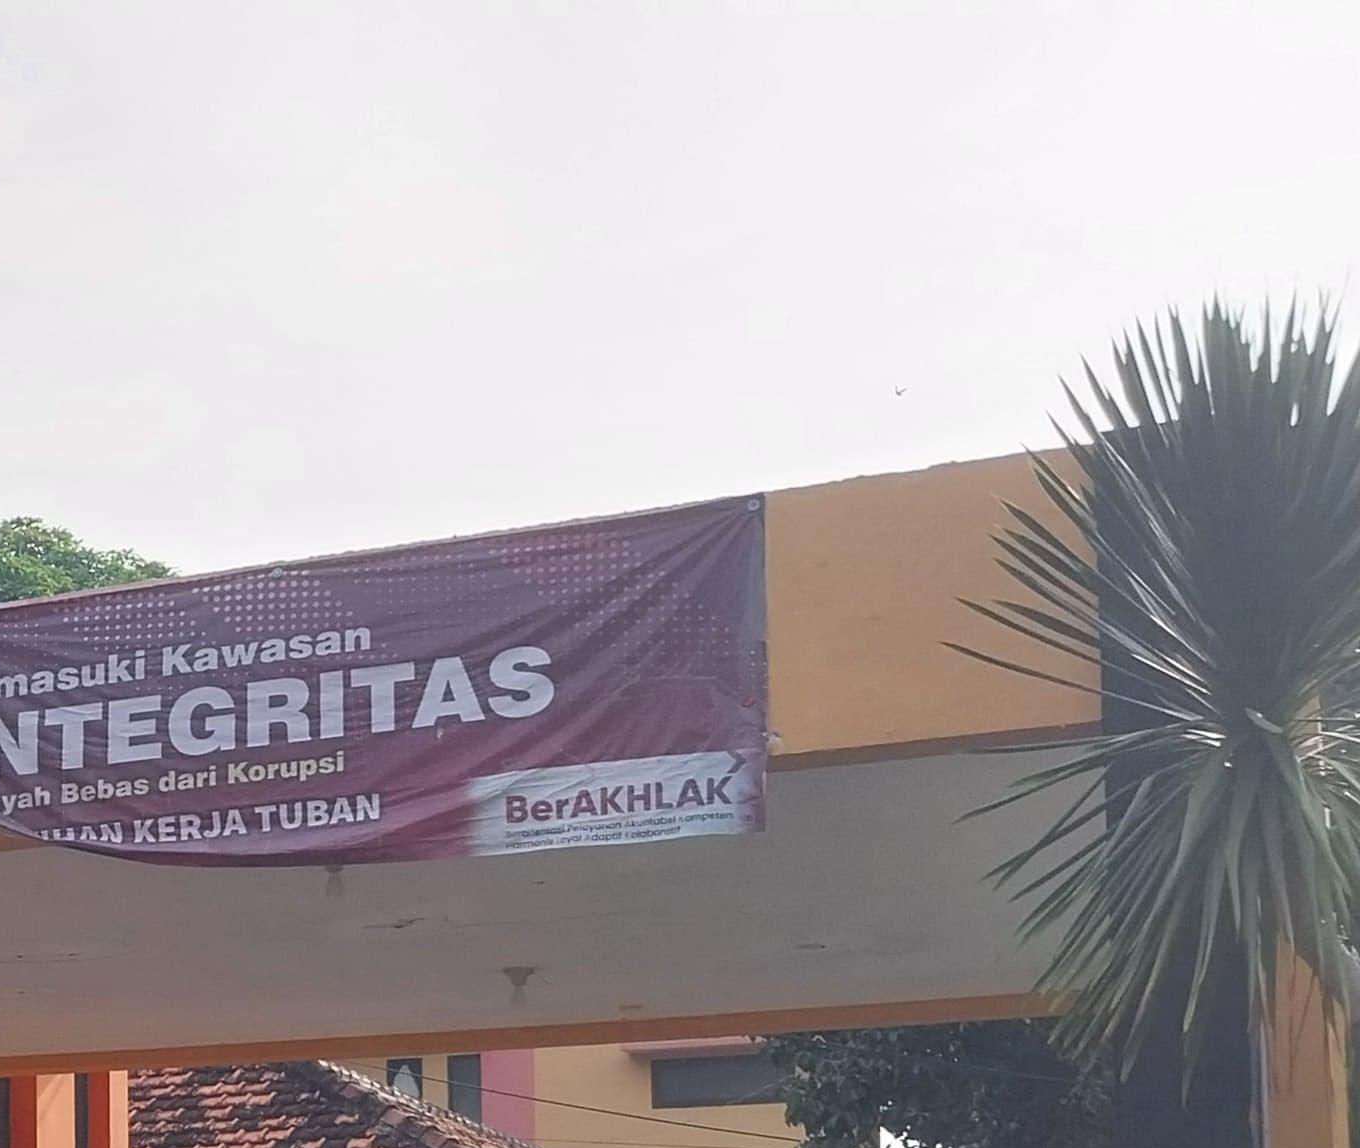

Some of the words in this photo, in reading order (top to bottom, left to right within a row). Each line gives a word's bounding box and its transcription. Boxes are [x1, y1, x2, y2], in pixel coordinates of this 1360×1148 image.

[162, 627, 372, 677] Kawasan
[61, 778, 149, 804] Bebas
[158, 764, 217, 793] dari
[227, 750, 346, 786] Korupsi
[505, 775, 733, 824] BerAKHLAK
[133, 809, 248, 844] KERJA
[254, 793, 381, 834] TUBAN
